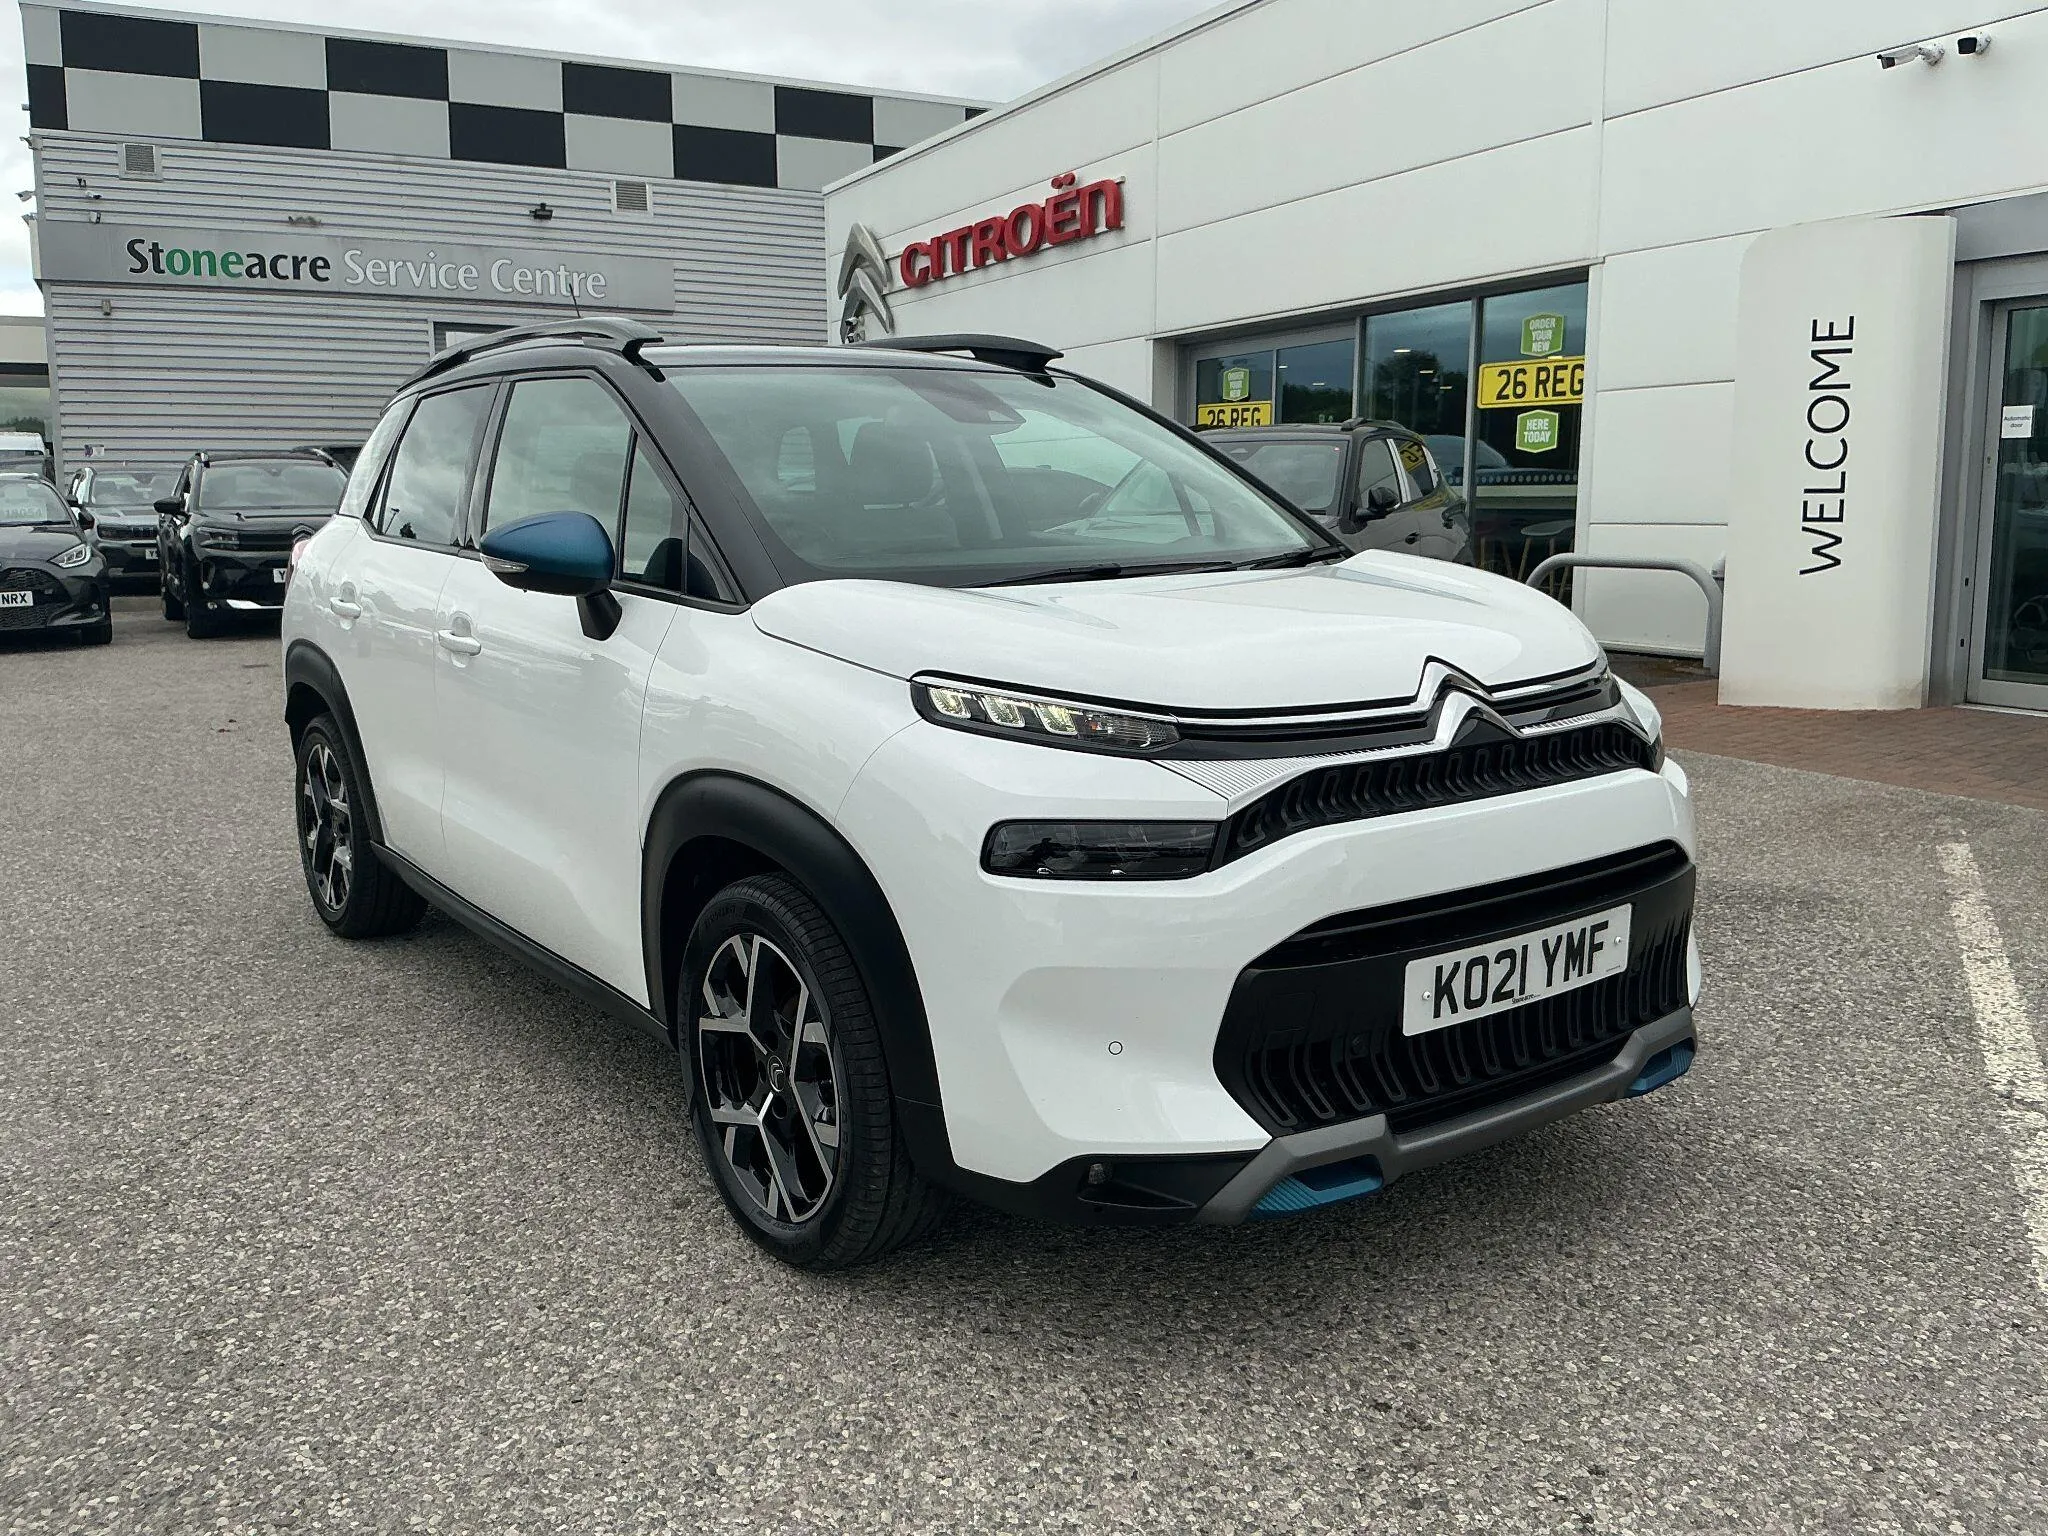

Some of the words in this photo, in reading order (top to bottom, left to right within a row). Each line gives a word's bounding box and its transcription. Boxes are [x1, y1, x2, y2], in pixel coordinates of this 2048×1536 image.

[126, 238, 331, 282] Stoneacre
[343, 249, 479, 291] Service
[490, 259, 607, 299] Centre
[1529, 318, 1556, 331] ORDER
[1532, 330, 1553, 342] YOUR
[1531, 341, 1550, 353] NEW
[1495, 368, 1528, 401] 26
[1534, 363, 1585, 399] REG
[1526, 418, 1549, 431] HERE
[1523, 430, 1552, 444] TODAY
[1799, 316, 1854, 575] WELCOME
[1, 593, 28, 605] NRX
[1432, 944, 1529, 1020] KO21
[1542, 919, 1610, 989] YMF
